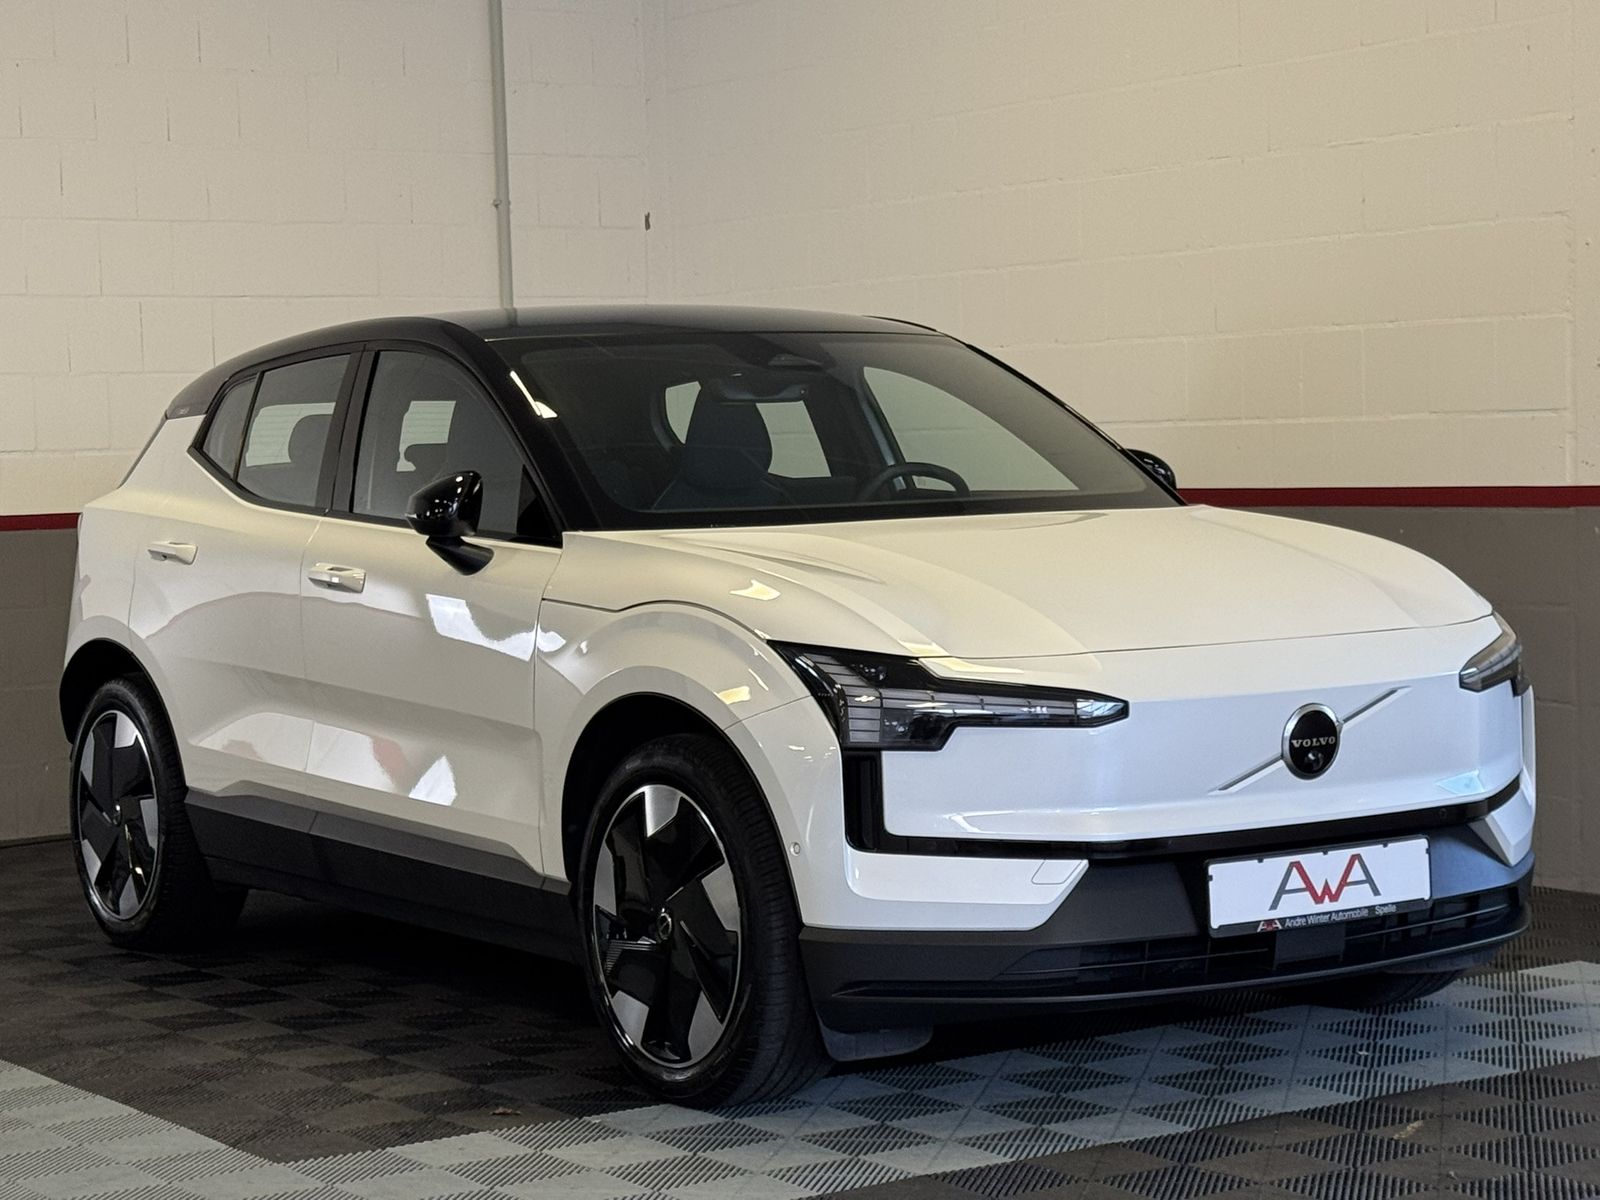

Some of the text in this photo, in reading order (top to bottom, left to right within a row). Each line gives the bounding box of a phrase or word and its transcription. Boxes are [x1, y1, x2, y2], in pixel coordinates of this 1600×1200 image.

[1291, 736, 1336, 748] VOLVO
[1284, 918, 1306, 928] Andre
[1307, 914, 1330, 925] Winter
[1331, 908, 1369, 921] Automobile
